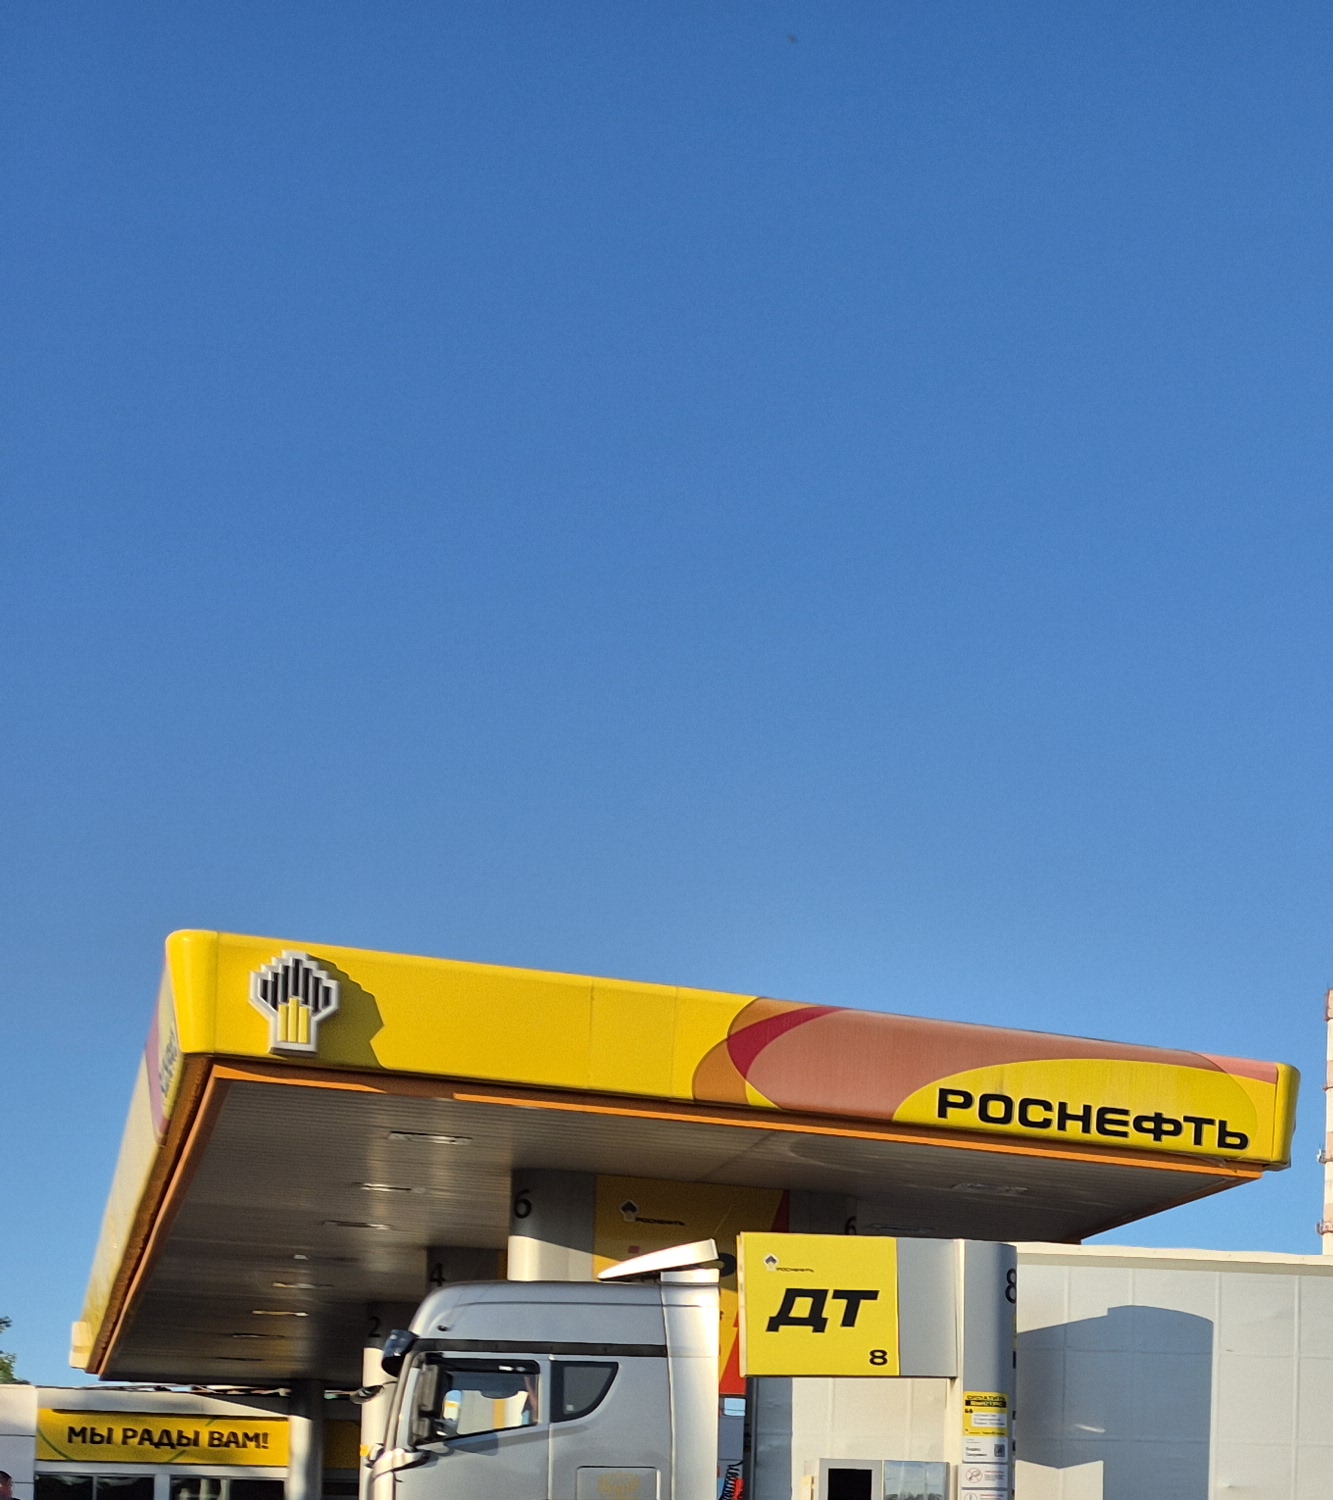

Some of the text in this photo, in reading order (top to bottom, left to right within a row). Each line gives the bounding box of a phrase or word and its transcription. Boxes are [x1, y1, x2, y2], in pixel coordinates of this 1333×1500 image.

[937, 1087, 1249, 1150] РОСНЕФТЬ
[513, 1189, 532, 1219] 6
[429, 1263, 446, 1287] 4
[765, 1288, 880, 1333] ДТ
[368, 1316, 381, 1338] 2
[868, 1349, 888, 1366] 8
[67, 1426, 270, 1449] МЫ РАДЫ ВАМ!
